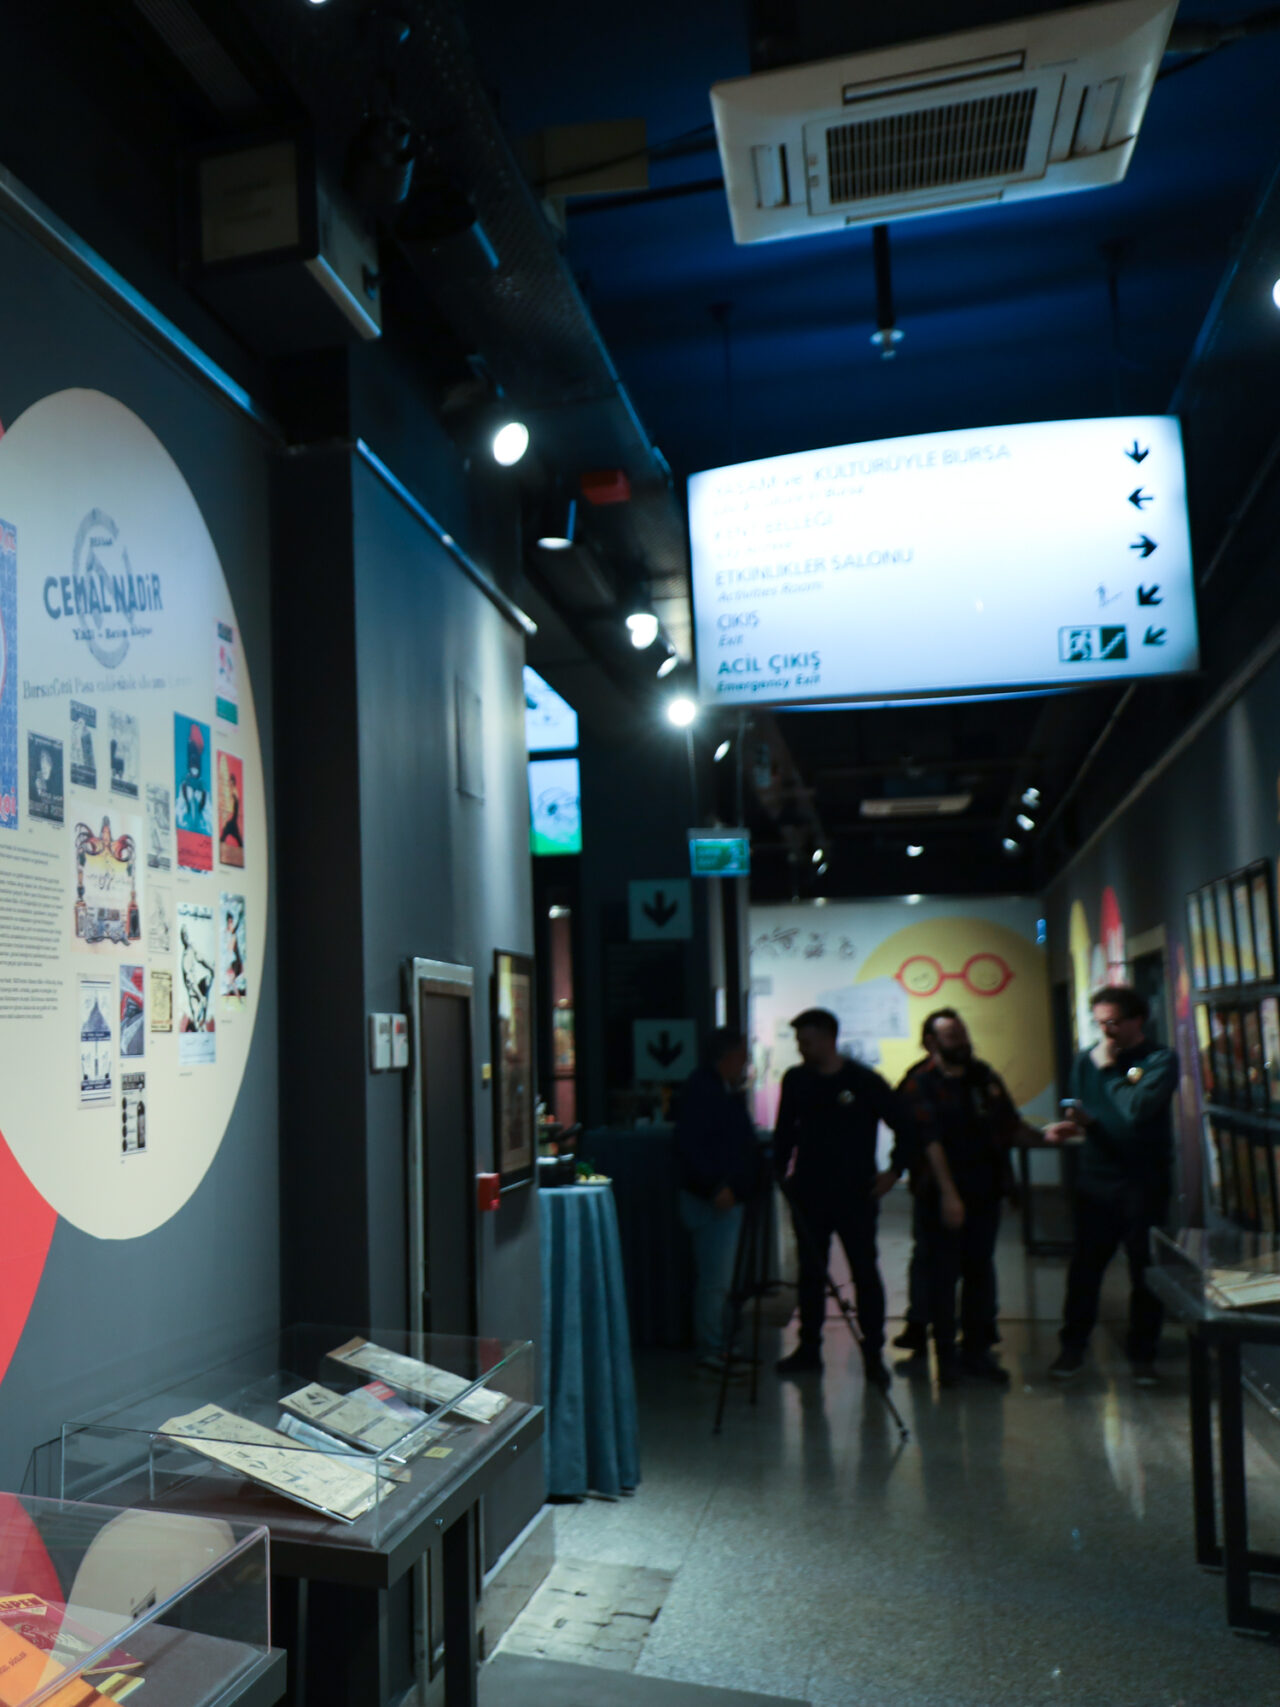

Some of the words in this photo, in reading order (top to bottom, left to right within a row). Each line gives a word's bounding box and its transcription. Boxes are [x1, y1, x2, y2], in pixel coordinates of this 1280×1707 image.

[941, 443, 1013, 466] BURSA
[831, 548, 915, 573] SALONU
[42, 574, 112, 621] CEMAL
[112, 571, 164, 614] NADİR
[718, 609, 761, 632] ÇIKIŞ
[718, 650, 764, 677] ACİL
[768, 649, 822, 674] ÇIKIŞ
[718, 674, 792, 695] Emergency
[795, 671, 821, 687] Exit
